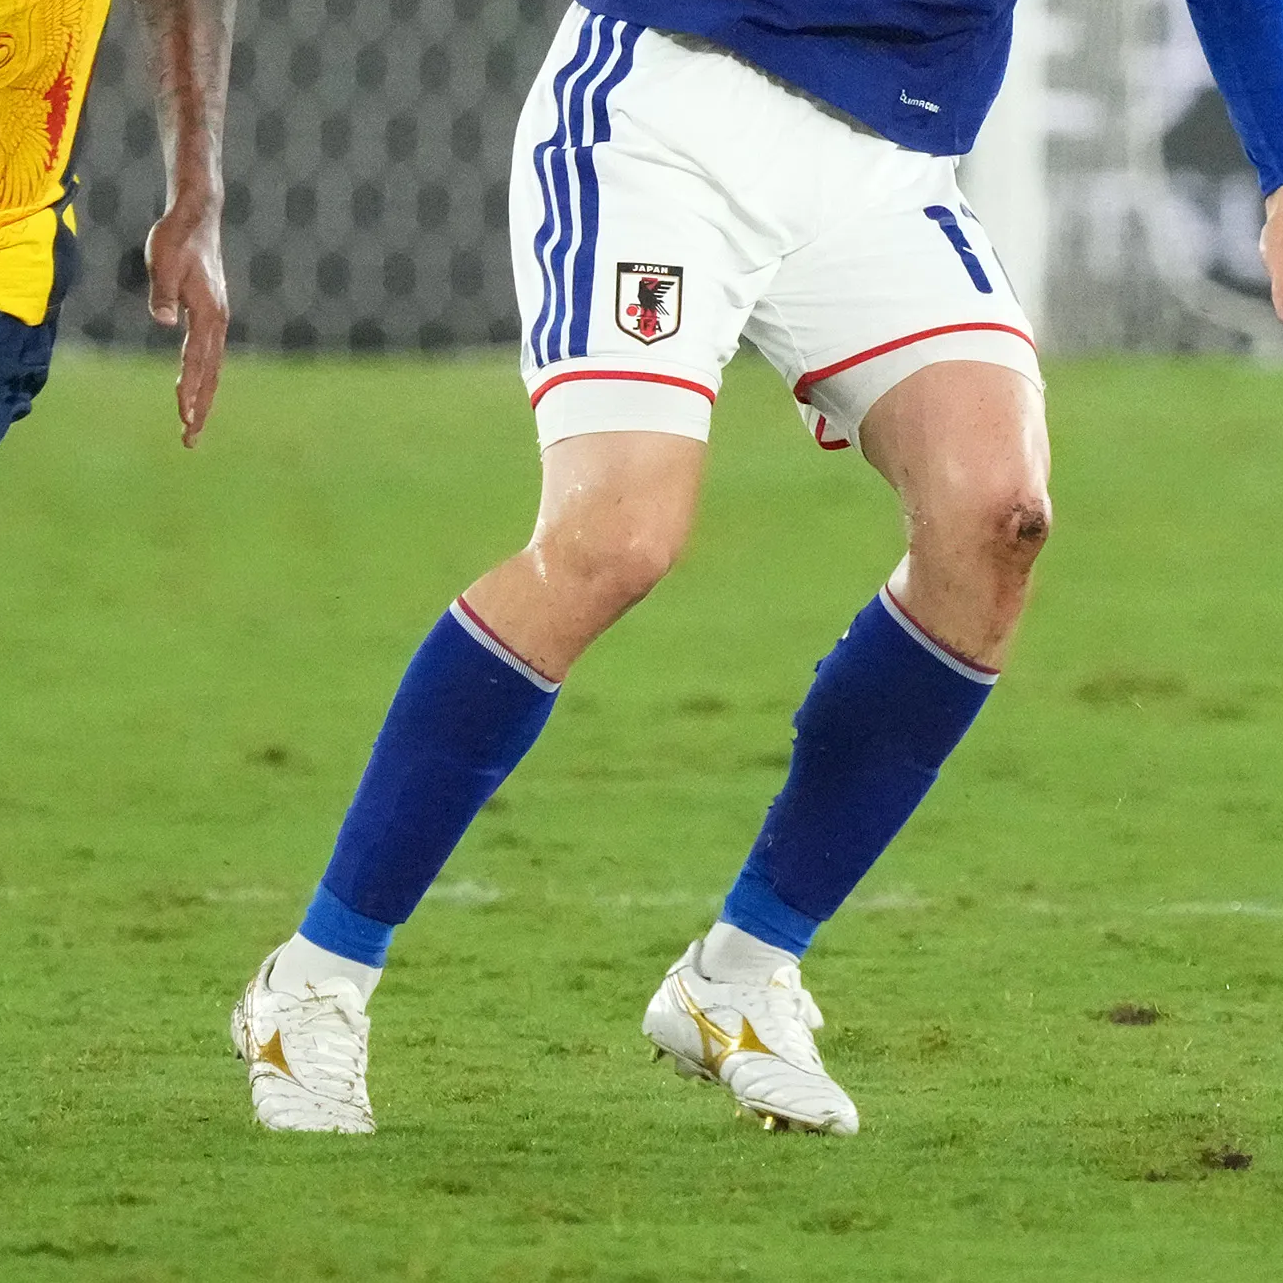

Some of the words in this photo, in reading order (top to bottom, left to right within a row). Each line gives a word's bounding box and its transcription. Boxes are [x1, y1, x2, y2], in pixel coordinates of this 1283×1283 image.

[923, 203, 1005, 295] 1
[632, 264, 669, 274] JAPAN
[632, 319, 663, 333] JFA
